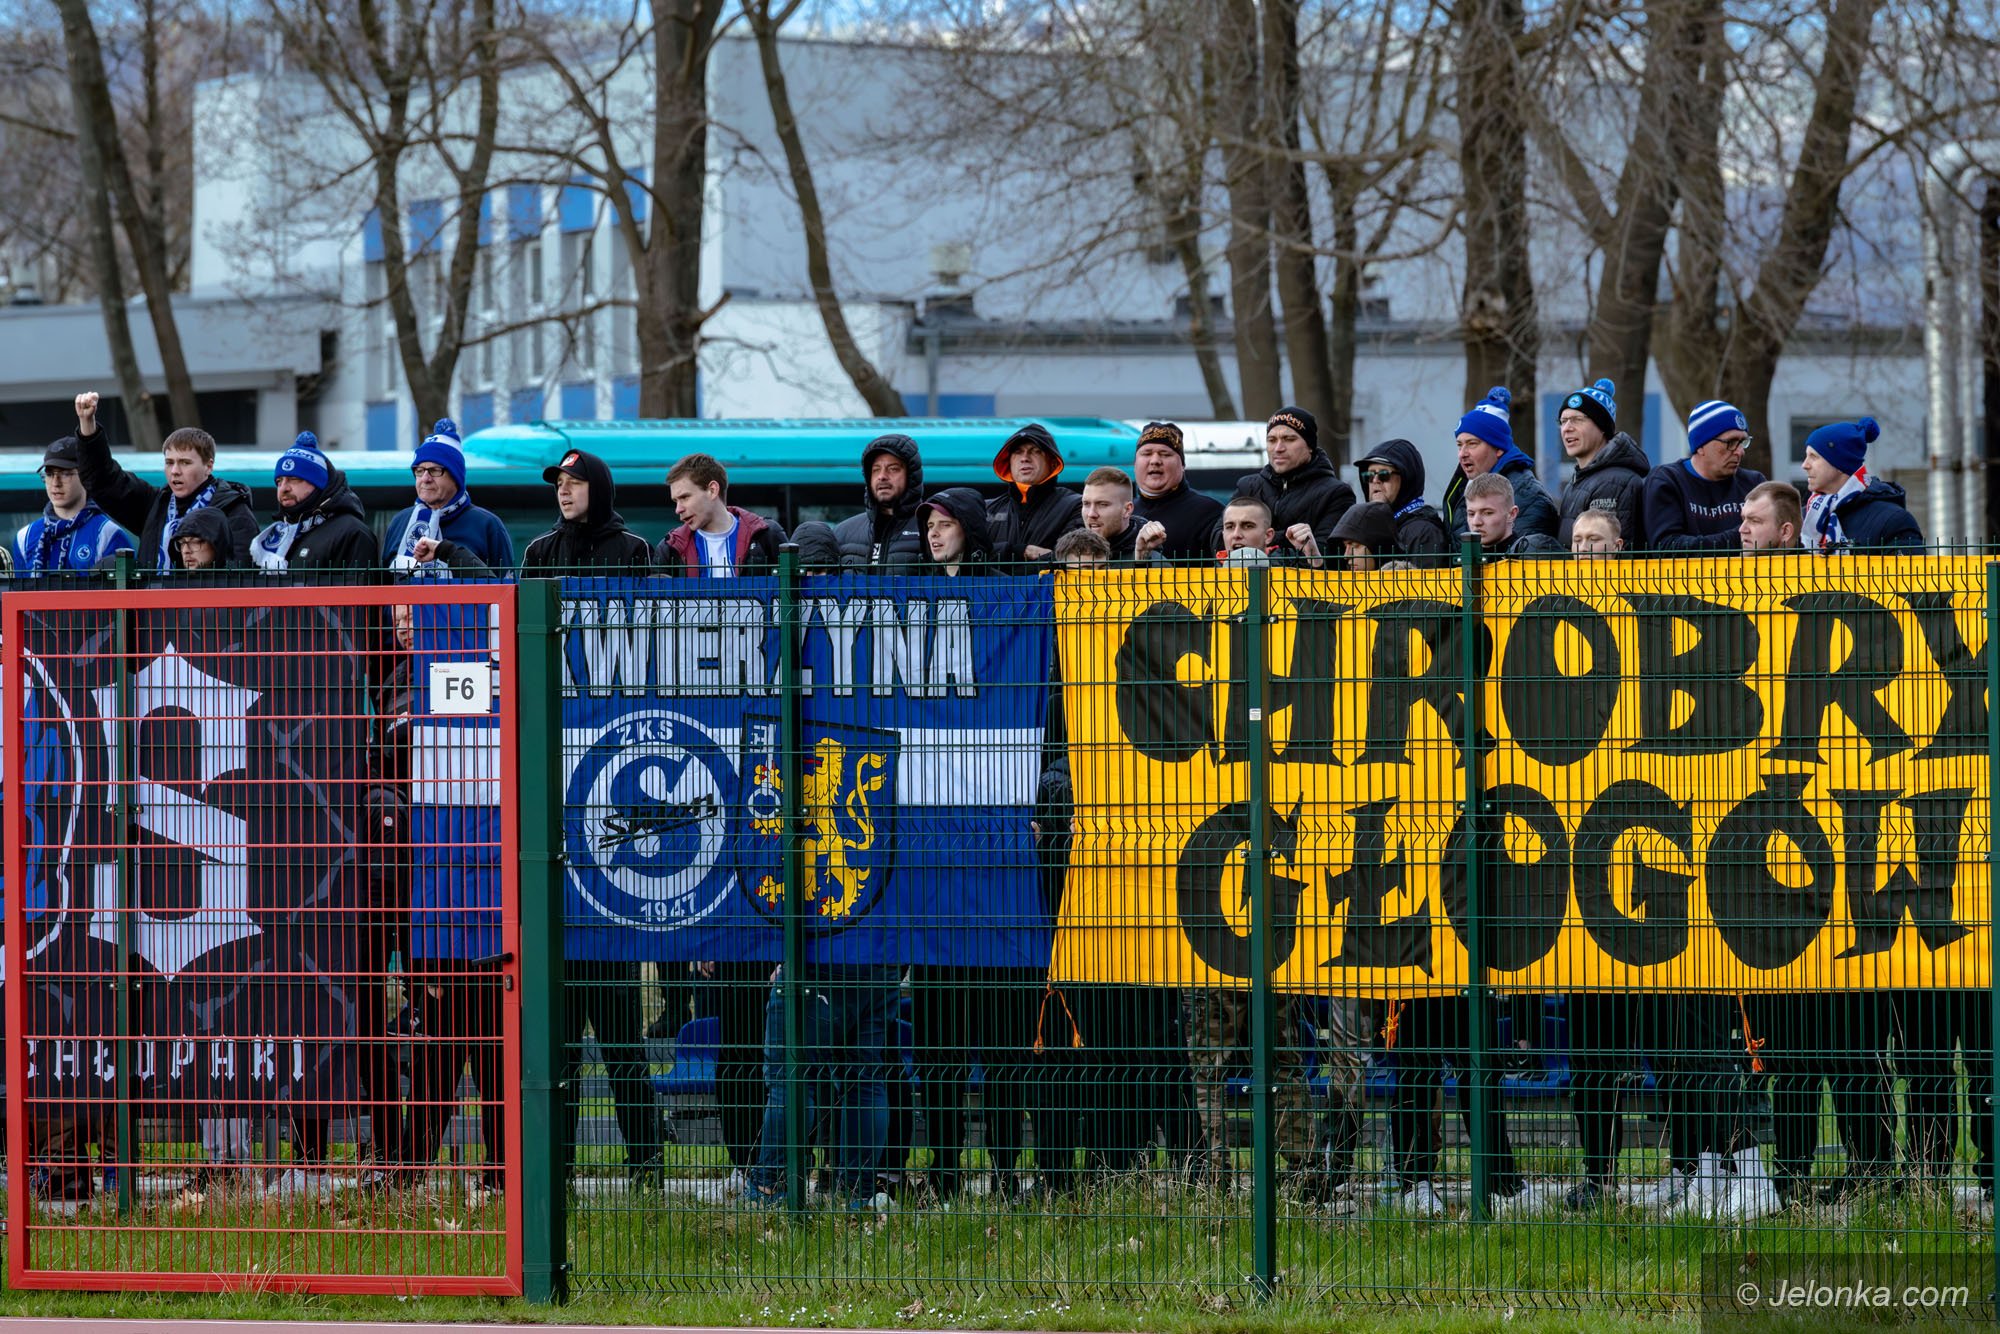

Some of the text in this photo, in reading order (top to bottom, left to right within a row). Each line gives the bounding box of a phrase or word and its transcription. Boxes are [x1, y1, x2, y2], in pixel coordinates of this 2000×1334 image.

[491, 597, 977, 698] WIERZYNA
[445, 676, 475, 701] F6
[1115, 590, 1989, 768] CHROBRY
[616, 719, 674, 746] ZKS
[641, 891, 697, 923] 1947
